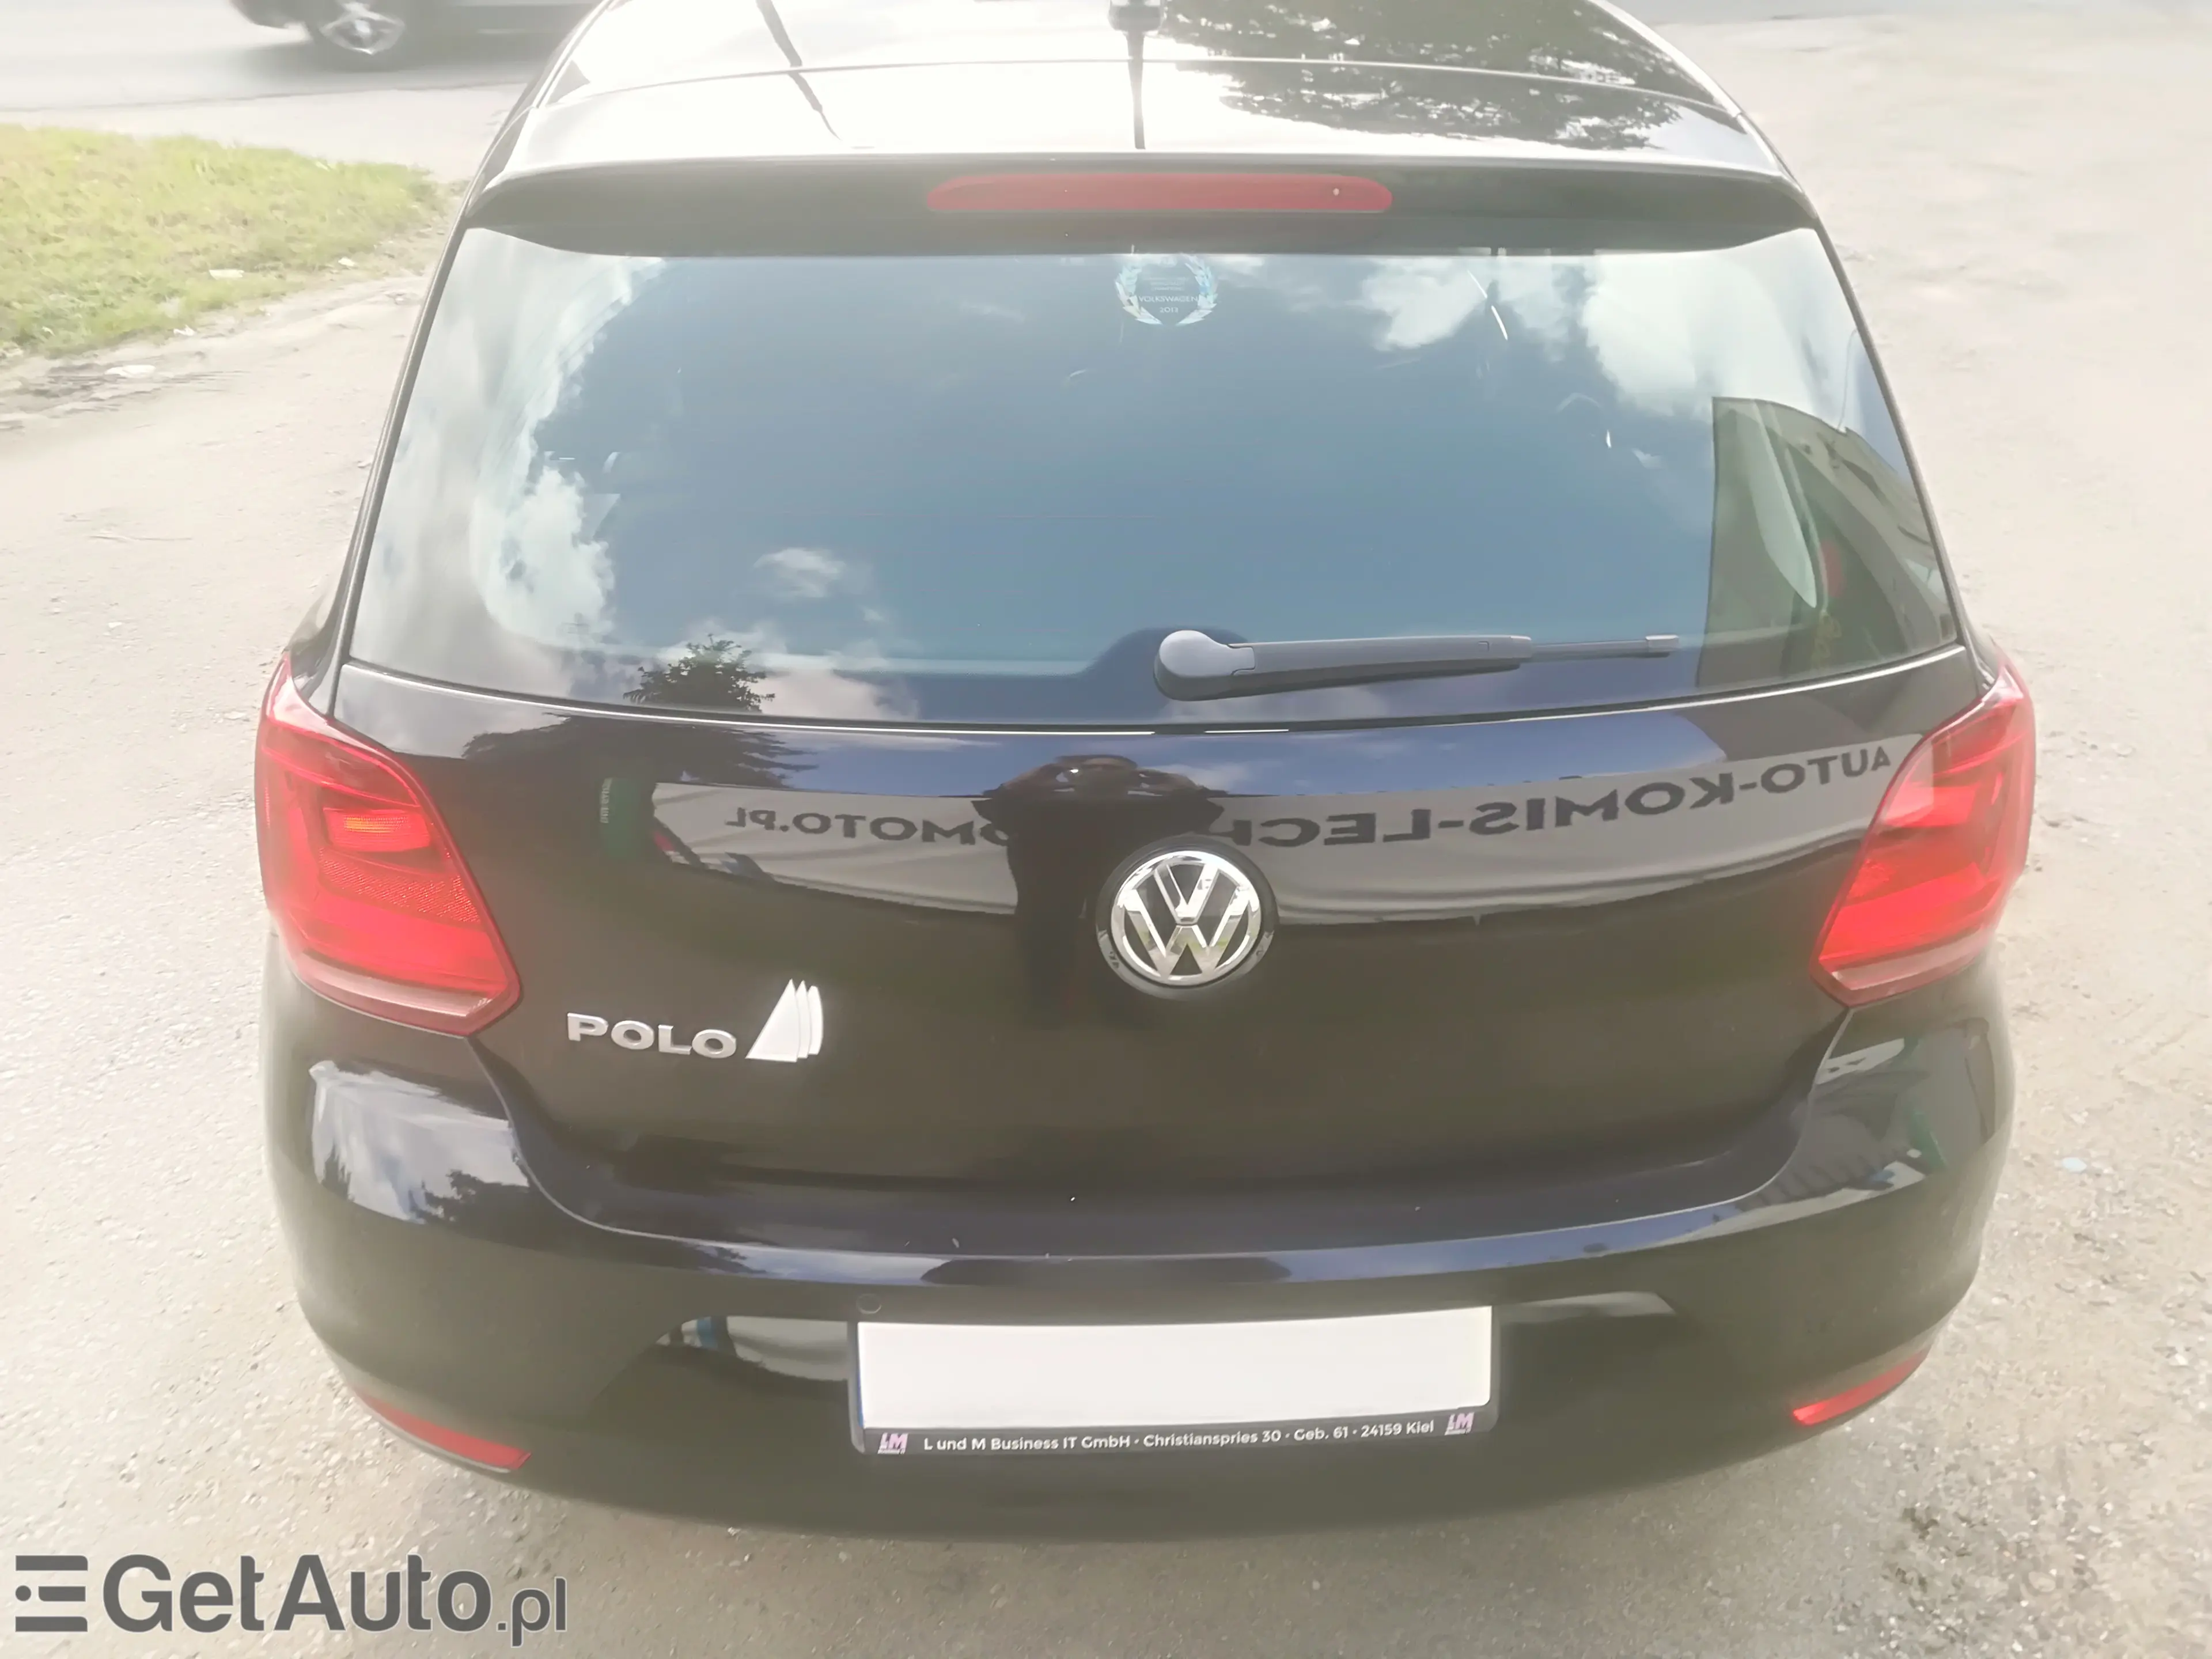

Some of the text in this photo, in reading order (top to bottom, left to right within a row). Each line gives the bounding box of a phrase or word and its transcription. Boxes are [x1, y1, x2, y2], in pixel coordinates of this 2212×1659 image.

[1138, 295, 1199, 303] VOLKSWAGEN
[567, 1012, 737, 1059] POLO
[924, 1438, 933, 1450] L
[937, 1437, 967, 1450] und
[971, 1437, 986, 1450] M
[991, 1437, 1059, 1450] Business
[1063, 1436, 1078, 1449] IT
[1081, 1435, 1130, 1449] GmbH
[1143, 1431, 1258, 1447] Christianspries
[1262, 1430, 1282, 1443] 30
[1294, 1427, 1329, 1441] Geb.
[1333, 1426, 1349, 1439] 61
[1361, 1423, 1402, 1438] 24159
[1406, 1419, 1434, 1434] Kiel
